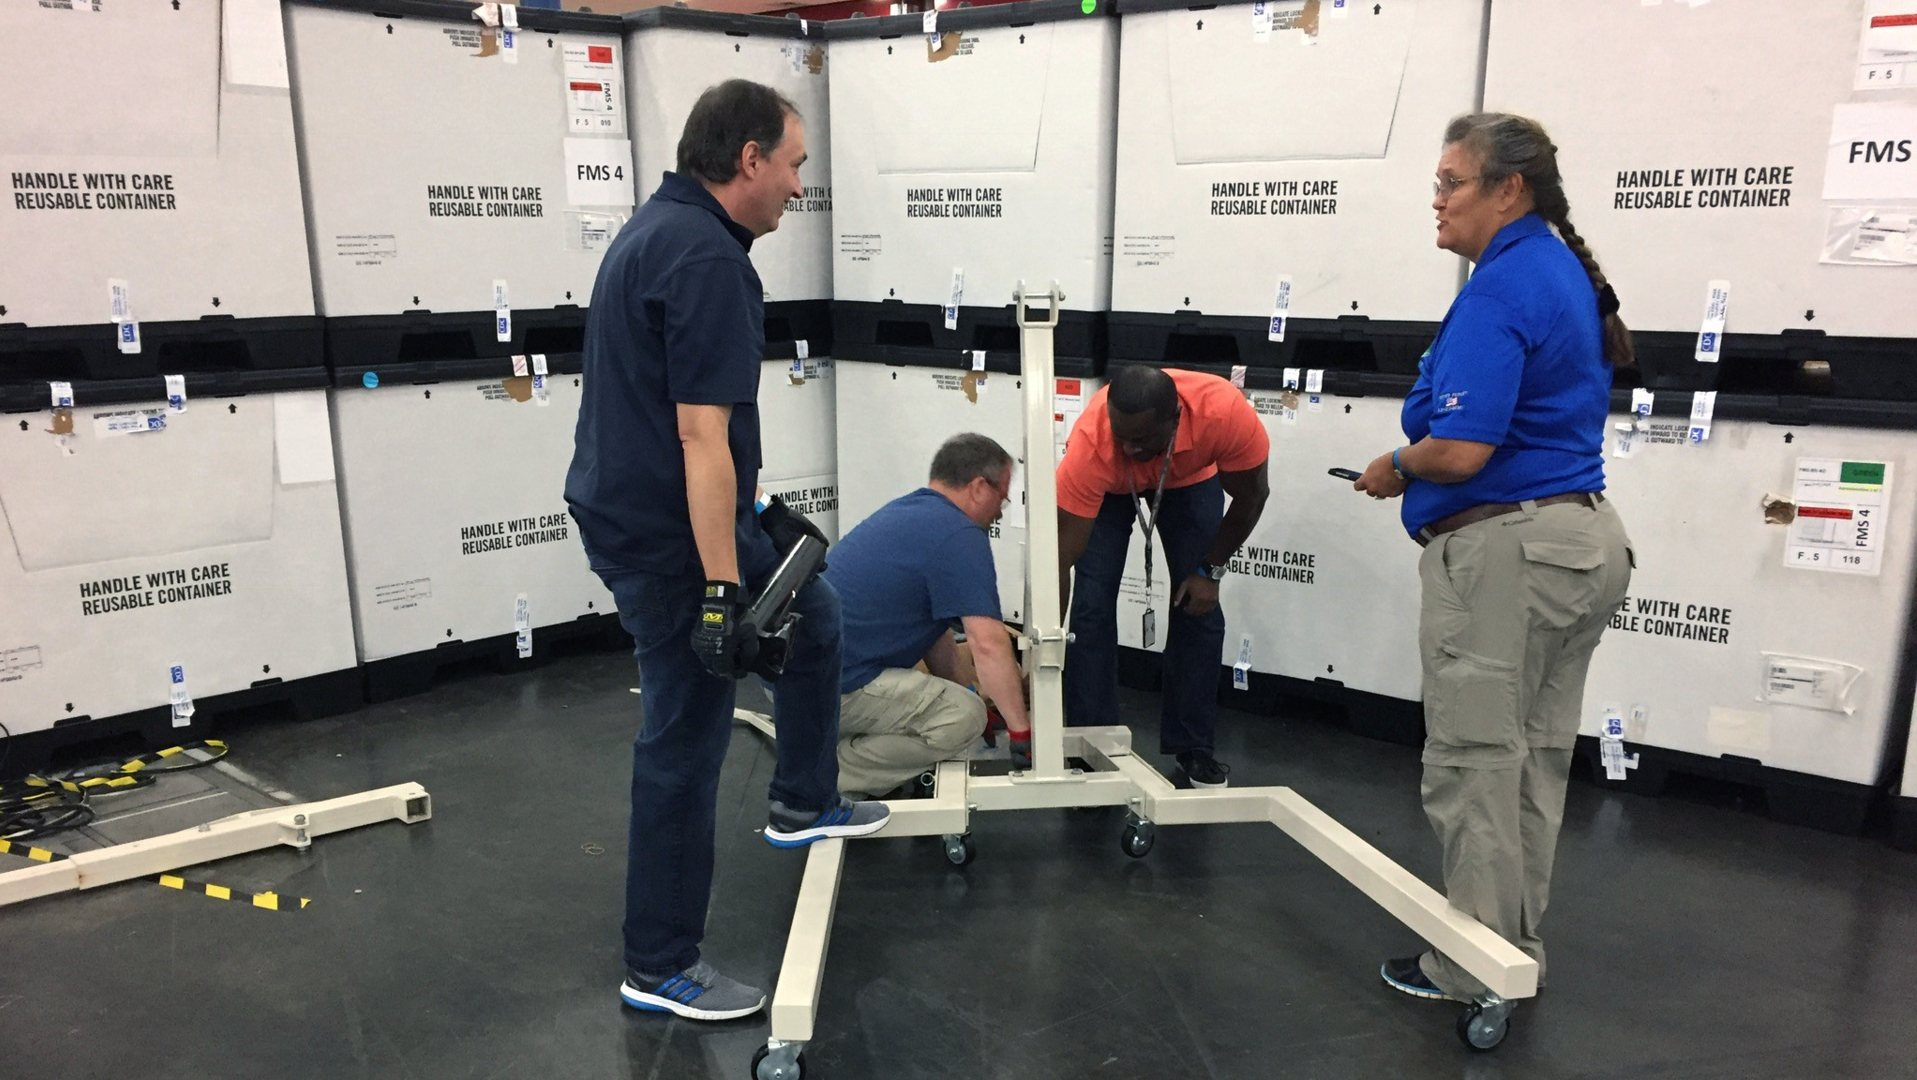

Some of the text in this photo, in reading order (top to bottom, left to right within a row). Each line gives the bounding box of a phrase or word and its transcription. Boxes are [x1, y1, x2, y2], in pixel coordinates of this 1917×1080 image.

[603, 83, 612, 103] FMS
[1849, 139, 1912, 163] FMS
[12, 172, 174, 190] HANDLE WITH CARE
[577, 165, 624, 181] FMS 4
[1616, 166, 1794, 188] HANDLE WITH CARE
[428, 185, 542, 201] HANDLE WITH CARE
[801, 186, 825, 198] WITH
[907, 188, 1002, 202] HANDLE WITH CARE
[1212, 180, 1338, 197] HANDLE WITH CARE
[14, 192, 176, 210] REUSABLE CONTAINER
[783, 200, 832, 212] ABLE CONTA
[1211, 199, 1337, 215] REUSABLE CONTAINER
[1614, 188, 1791, 209] REUSABLE CONTAINER
[429, 202, 543, 217] REUSABLE CONTAINER
[907, 204, 1002, 217] REUSABLE CONTAINER
[1701, 332, 1713, 351] CDC
[776, 486, 833, 504] ANDLE WITH
[461, 513, 567, 540] HANDLE WITH CARE
[1856, 509, 1870, 547] FMS 4
[462, 527, 568, 555] REUSABLE CONTAINER
[1247, 546, 1278, 563] WITH
[1283, 551, 1315, 568] CARE
[1843, 555, 1860, 565] 118
[80, 563, 230, 598] HANDLE WITH CARE
[1226, 560, 1315, 584] ABLE CONTAINER
[82, 580, 232, 616] REUSABLE CONTAINER
[1637, 598, 1679, 618] WITH
[1686, 604, 1732, 625] CARE
[1644, 618, 1729, 644] CONTAINER
